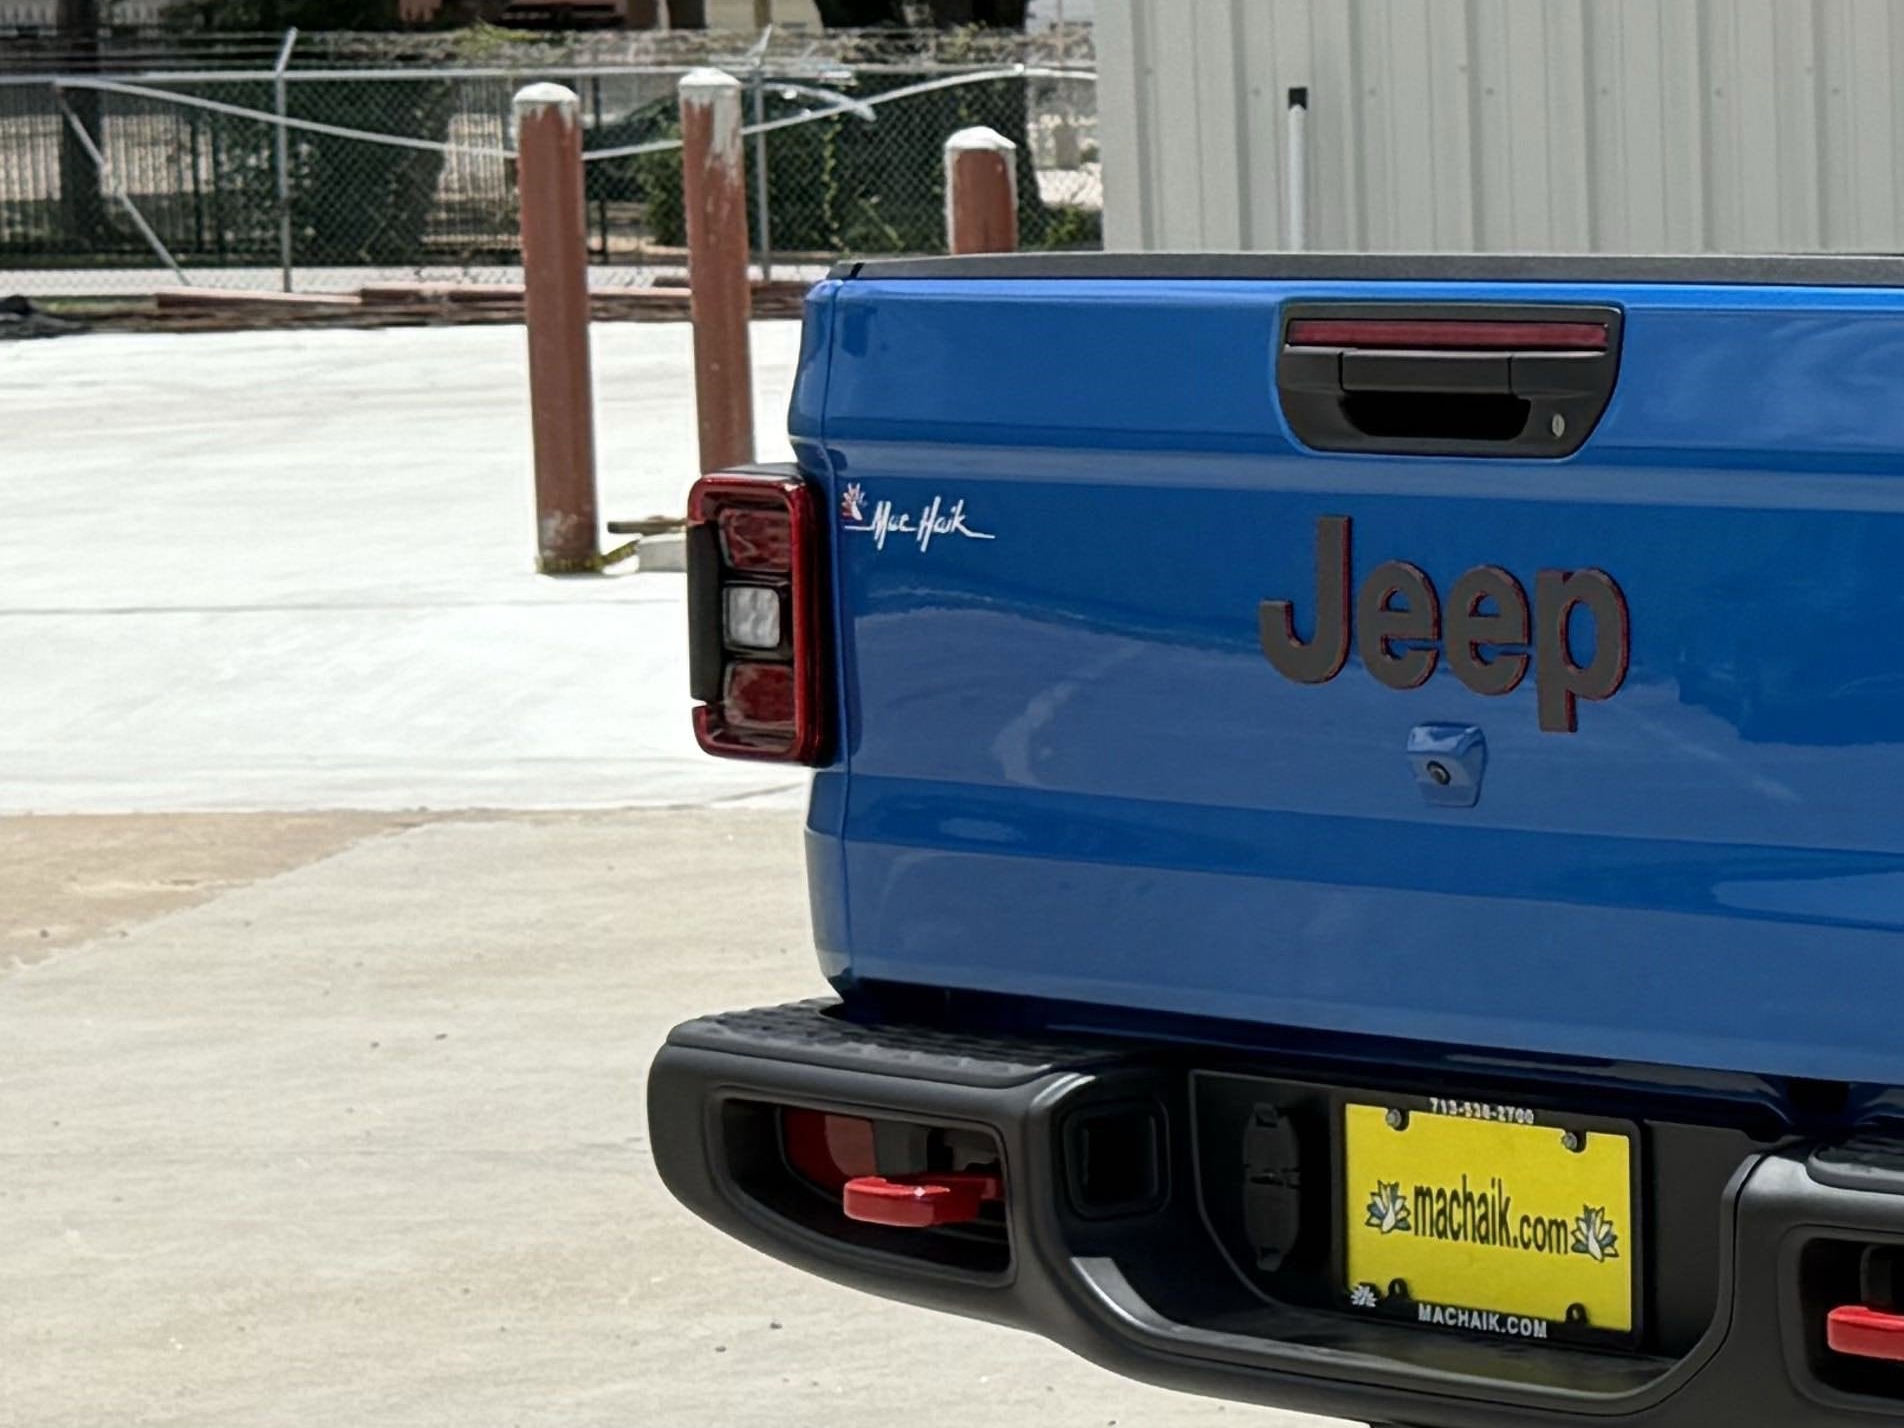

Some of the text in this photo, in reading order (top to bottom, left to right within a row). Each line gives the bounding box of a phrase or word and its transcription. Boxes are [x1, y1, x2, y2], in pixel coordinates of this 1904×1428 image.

[844, 496, 995, 552] Mac Haik
[1259, 515, 1630, 732] Jeep
[1413, 1174, 1568, 1255] machaik.com
[1418, 1303, 1547, 1338] MACHAIK.COM
